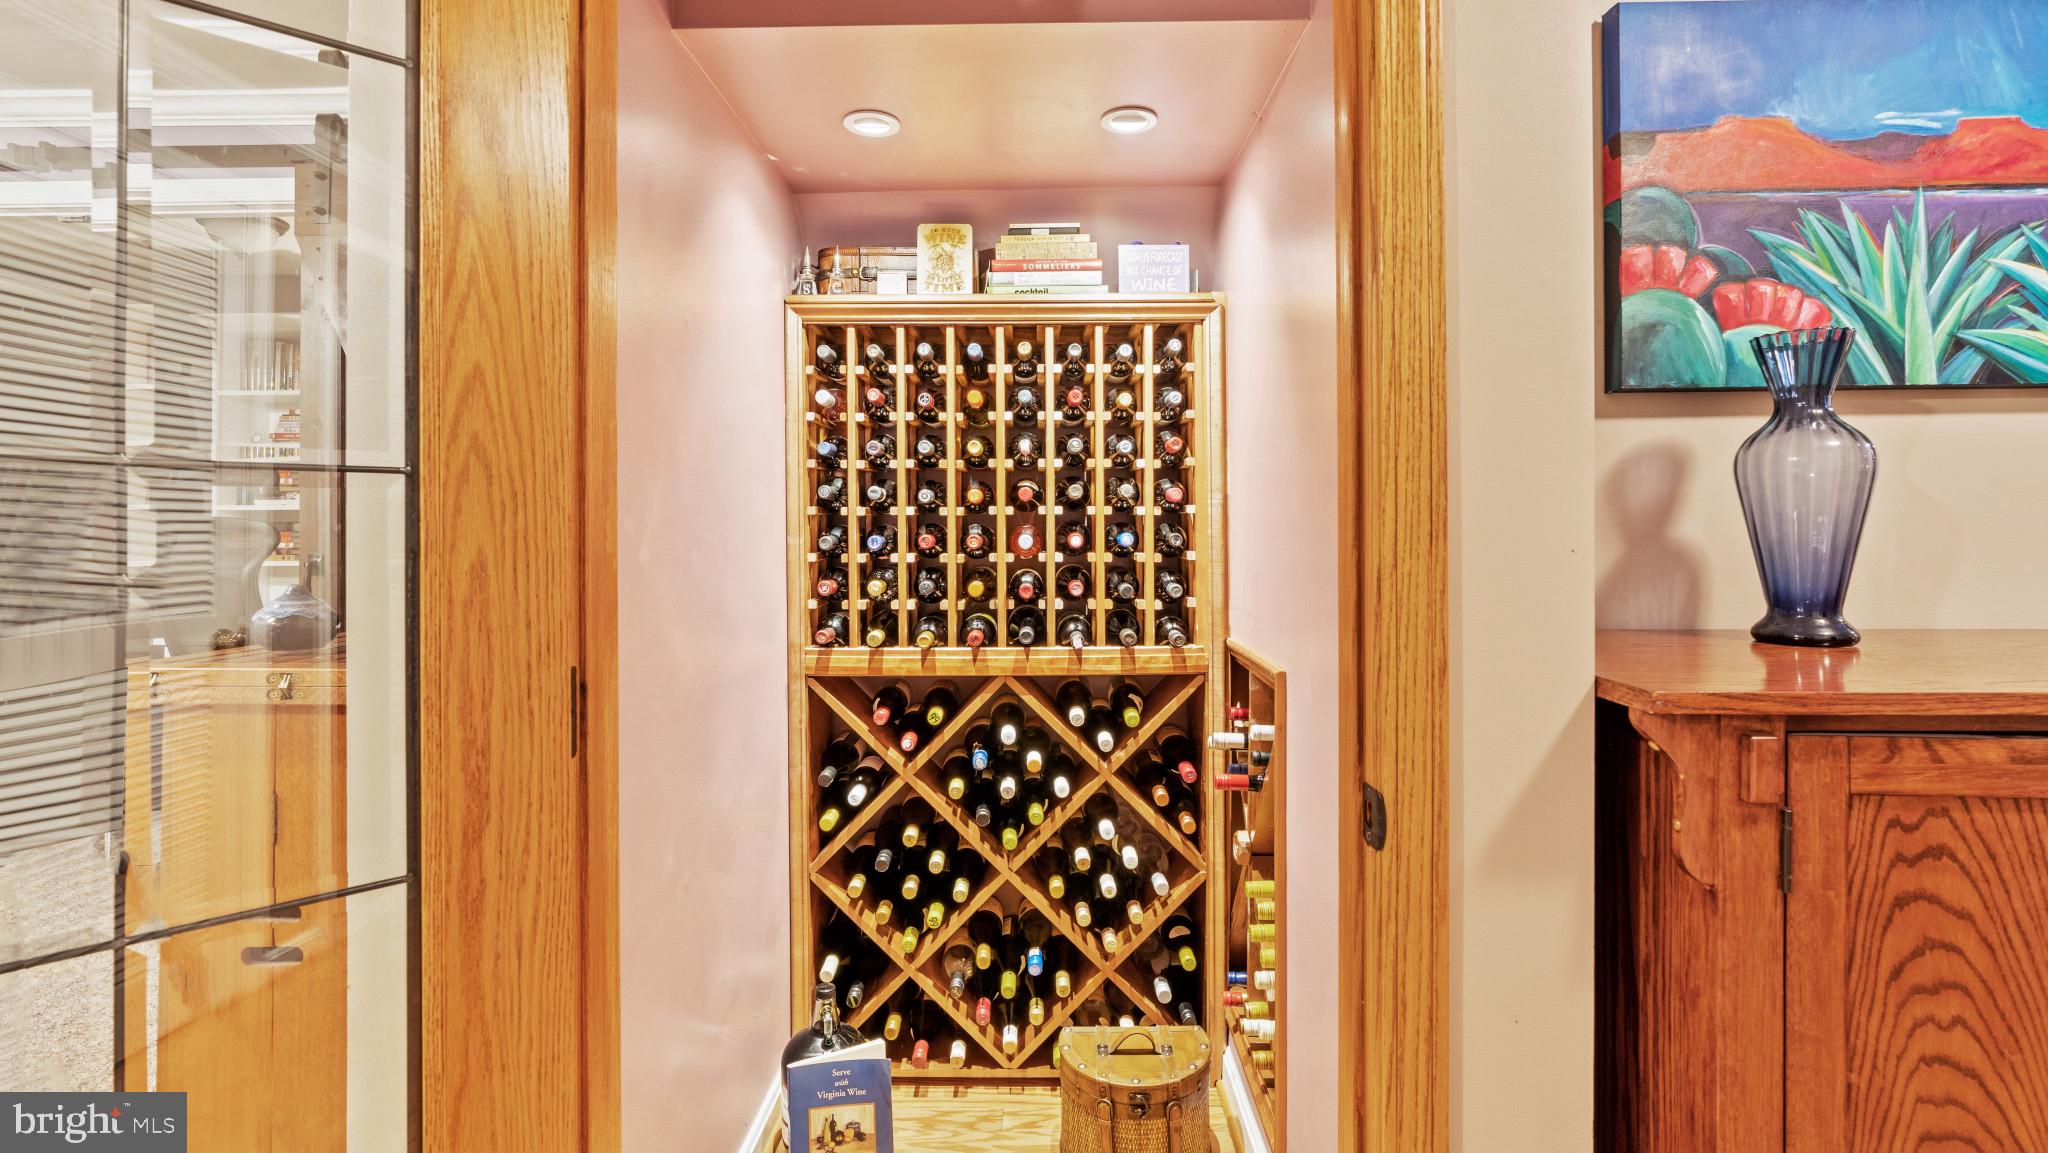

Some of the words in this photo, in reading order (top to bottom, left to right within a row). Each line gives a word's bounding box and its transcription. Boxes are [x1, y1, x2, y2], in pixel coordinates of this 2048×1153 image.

[1140, 264, 1172, 276] CHANCE
[803, 283, 811, 294] S
[832, 281, 842, 293] C
[1130, 277, 1177, 291] WINE
[832, 1069, 851, 1077] Serve
[834, 1078, 849, 1087] with
[816, 1089, 846, 1101] Virginia
[847, 1088, 867, 1096] Wine
